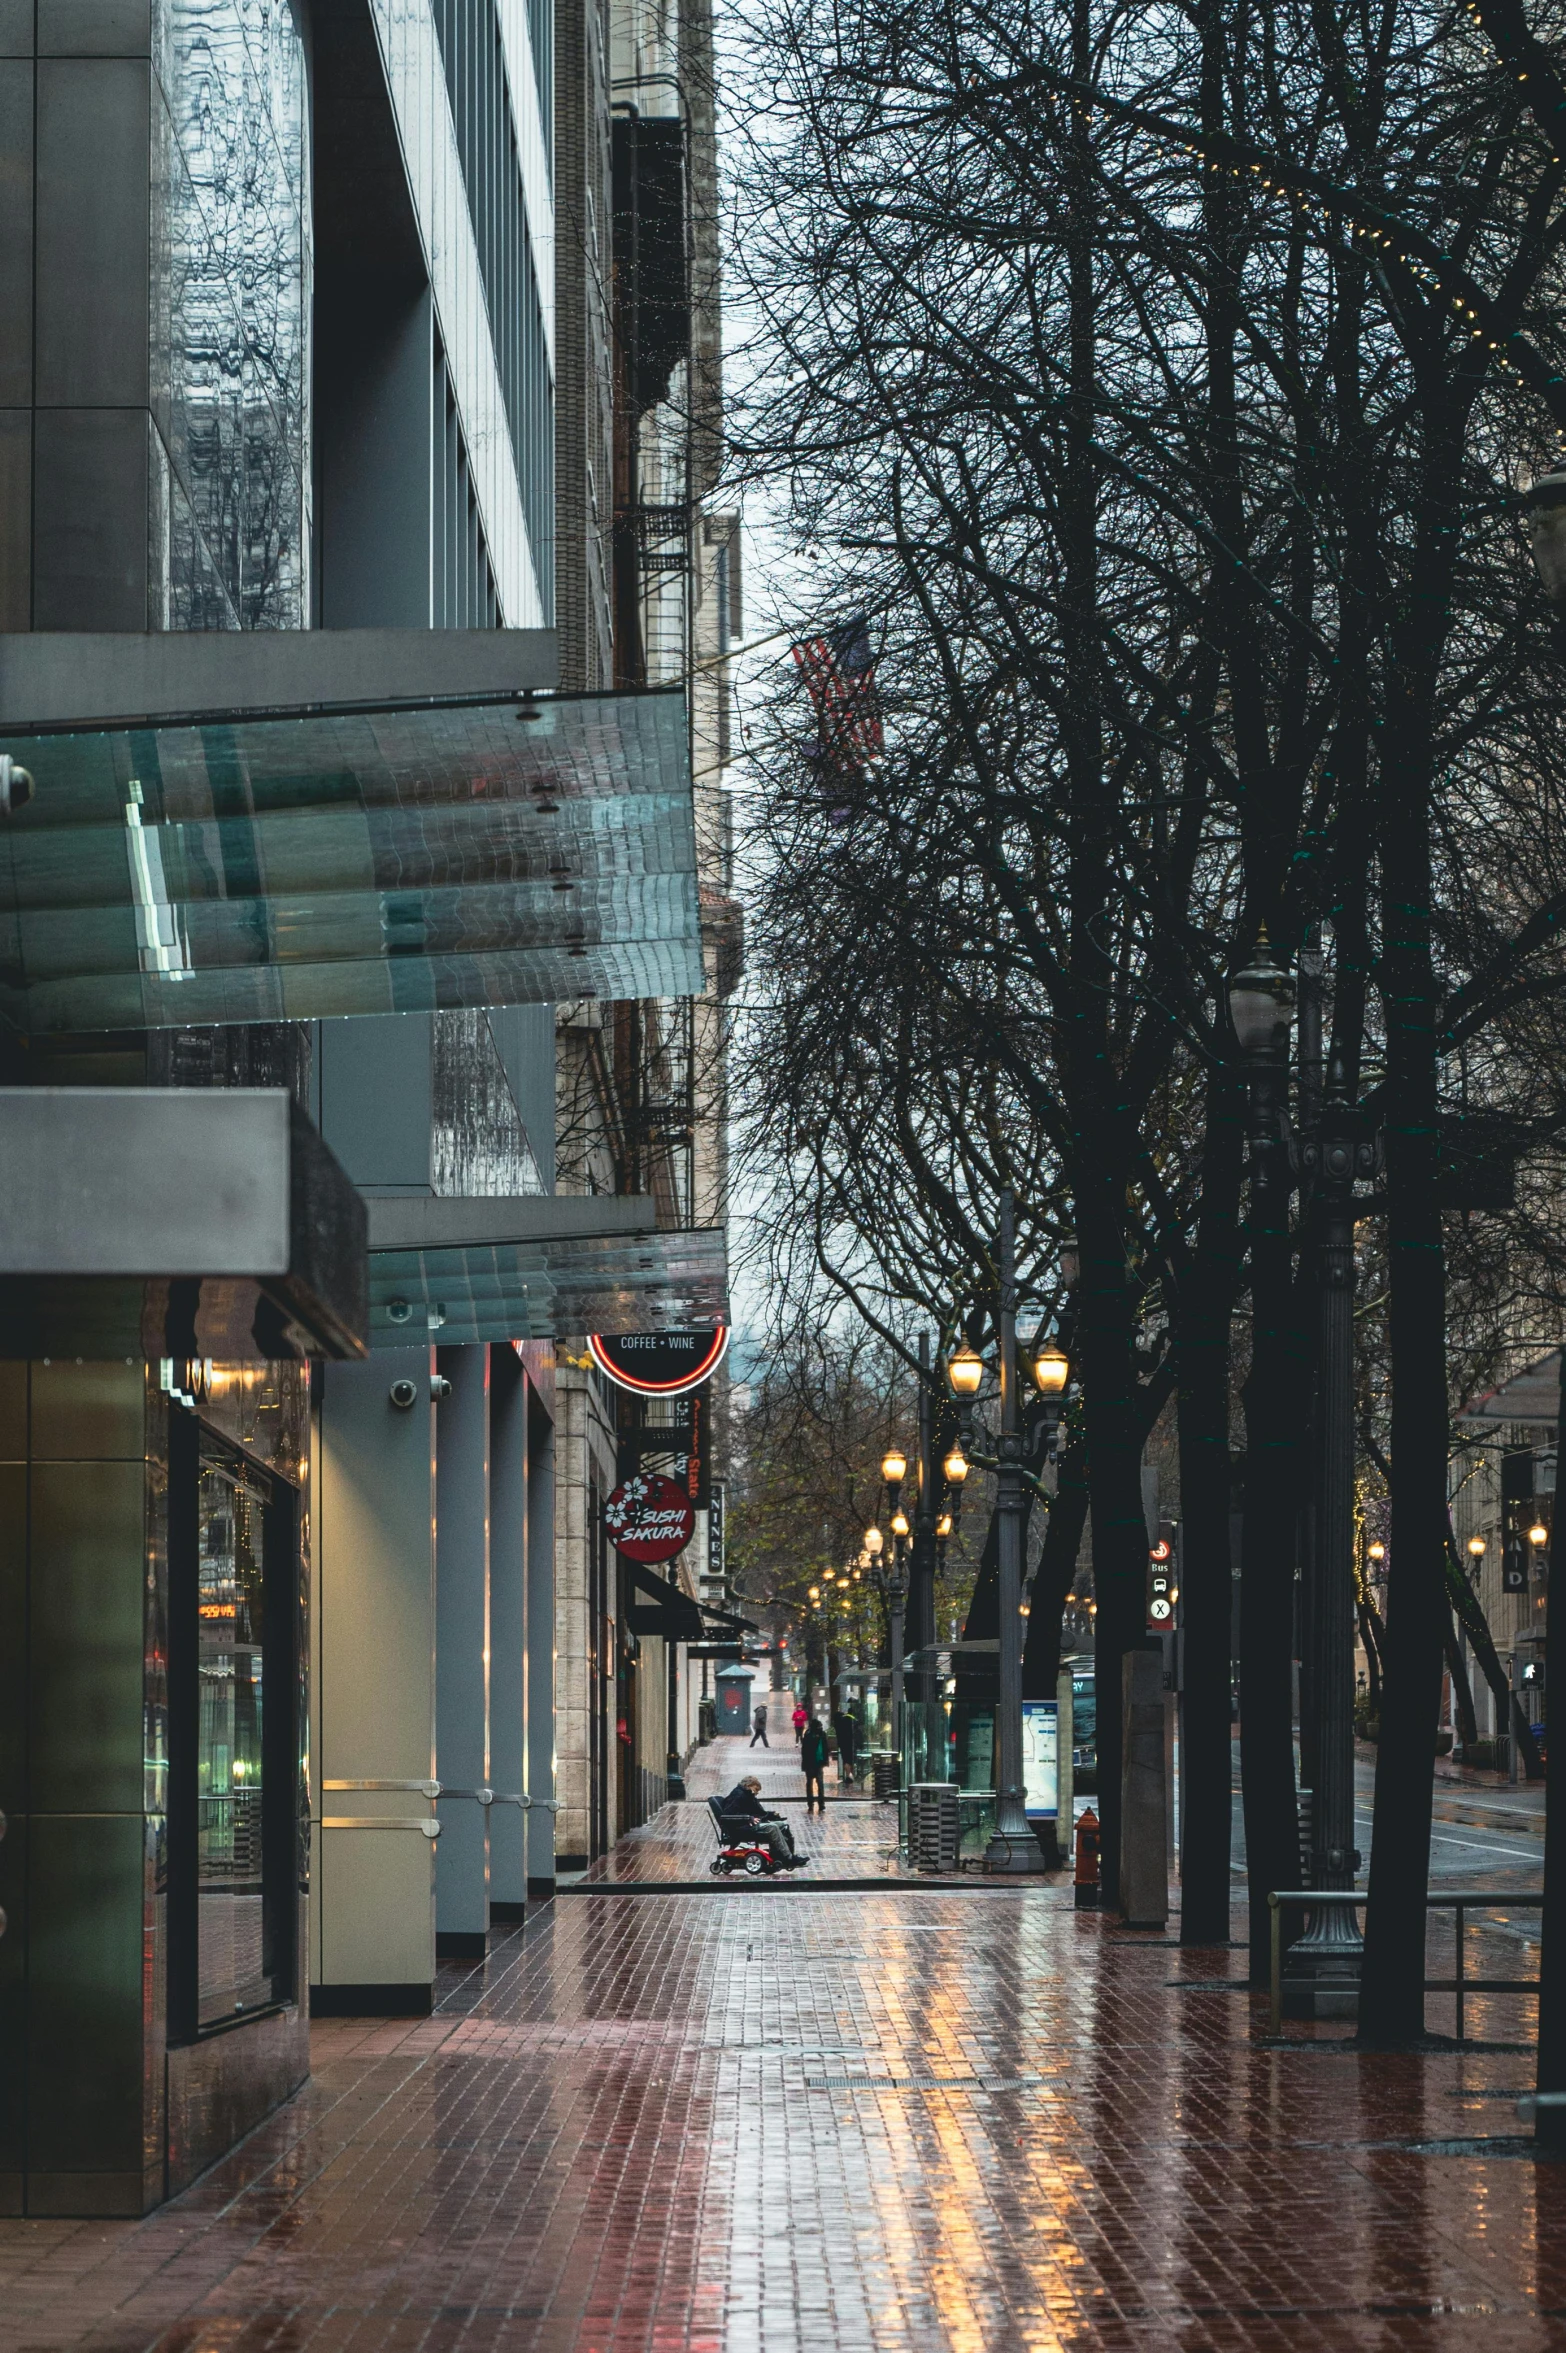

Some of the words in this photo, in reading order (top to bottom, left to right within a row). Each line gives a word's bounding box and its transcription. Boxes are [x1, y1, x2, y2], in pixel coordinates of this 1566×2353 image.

[621, 1336, 656, 1349] COFFEE
[669, 1336, 695, 1349] WINE
[688, 1459, 700, 1498] State
[640, 1509, 687, 1525] SUSHI
[621, 1526, 686, 1542] SAKURA
[711, 1499, 720, 1567] NINES
[1152, 1563, 1168, 1572] Bus
[1156, 1604, 1164, 1615] X
